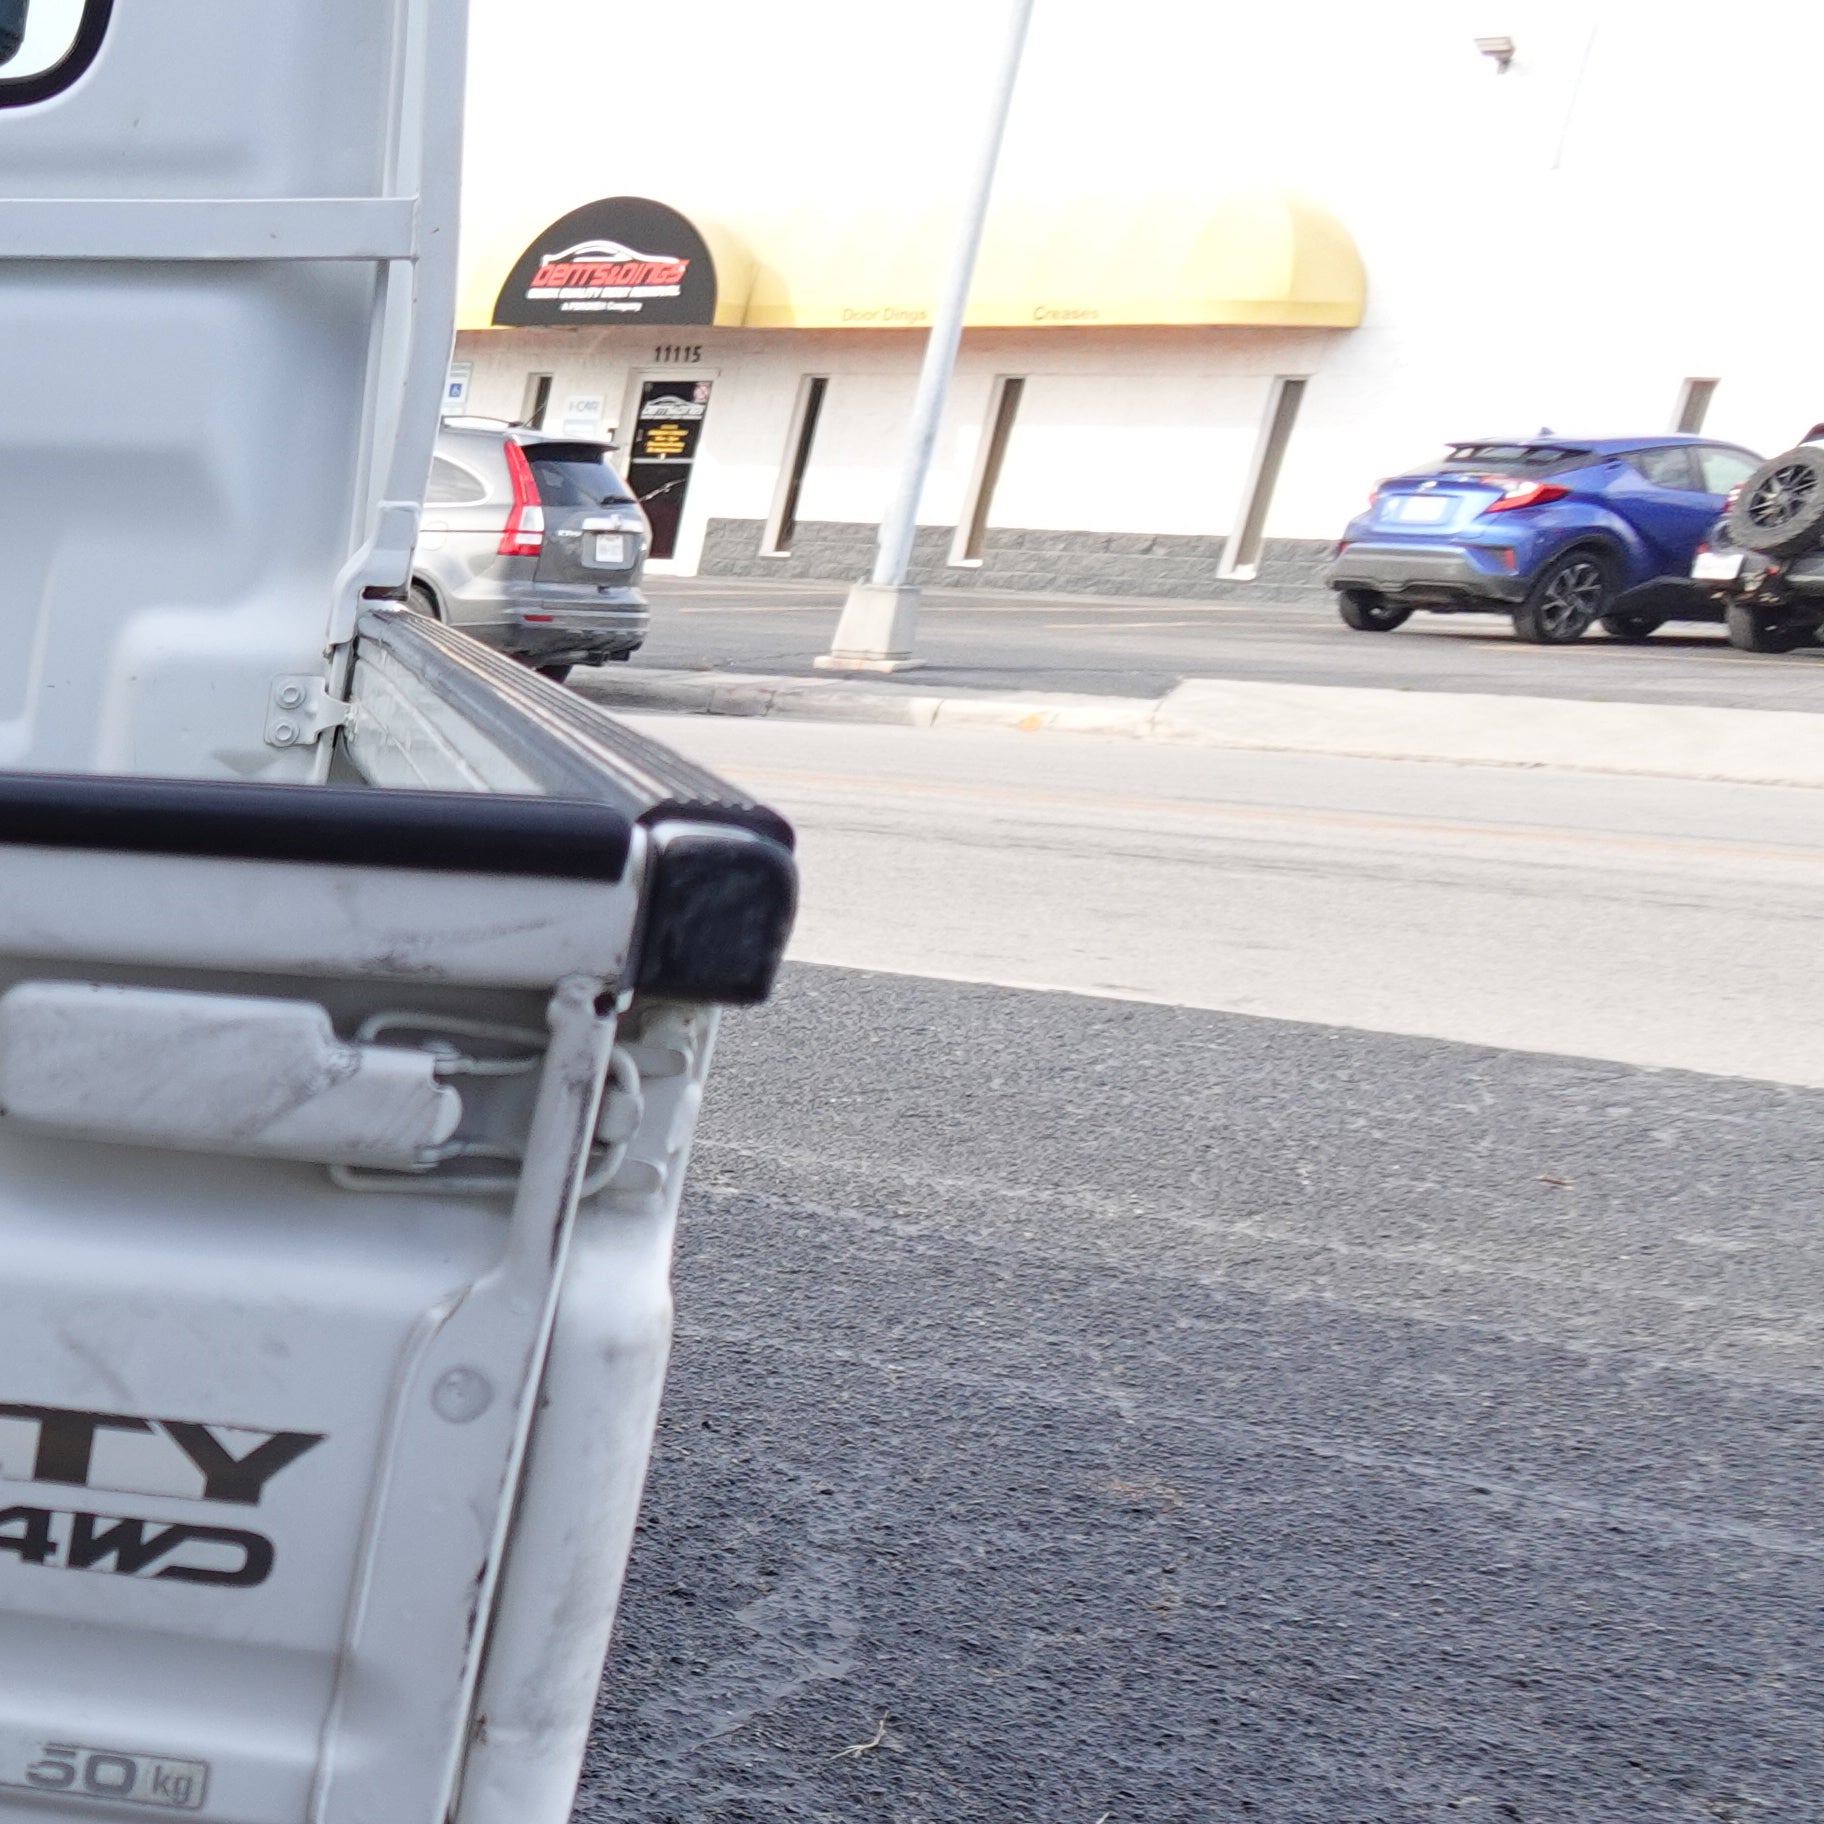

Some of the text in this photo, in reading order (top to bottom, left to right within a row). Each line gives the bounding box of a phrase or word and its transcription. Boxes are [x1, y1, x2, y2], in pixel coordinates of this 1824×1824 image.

[841, 307, 879, 322] Door
[654, 345, 703, 363] 11115
[153, 1764, 192, 1803] kg
